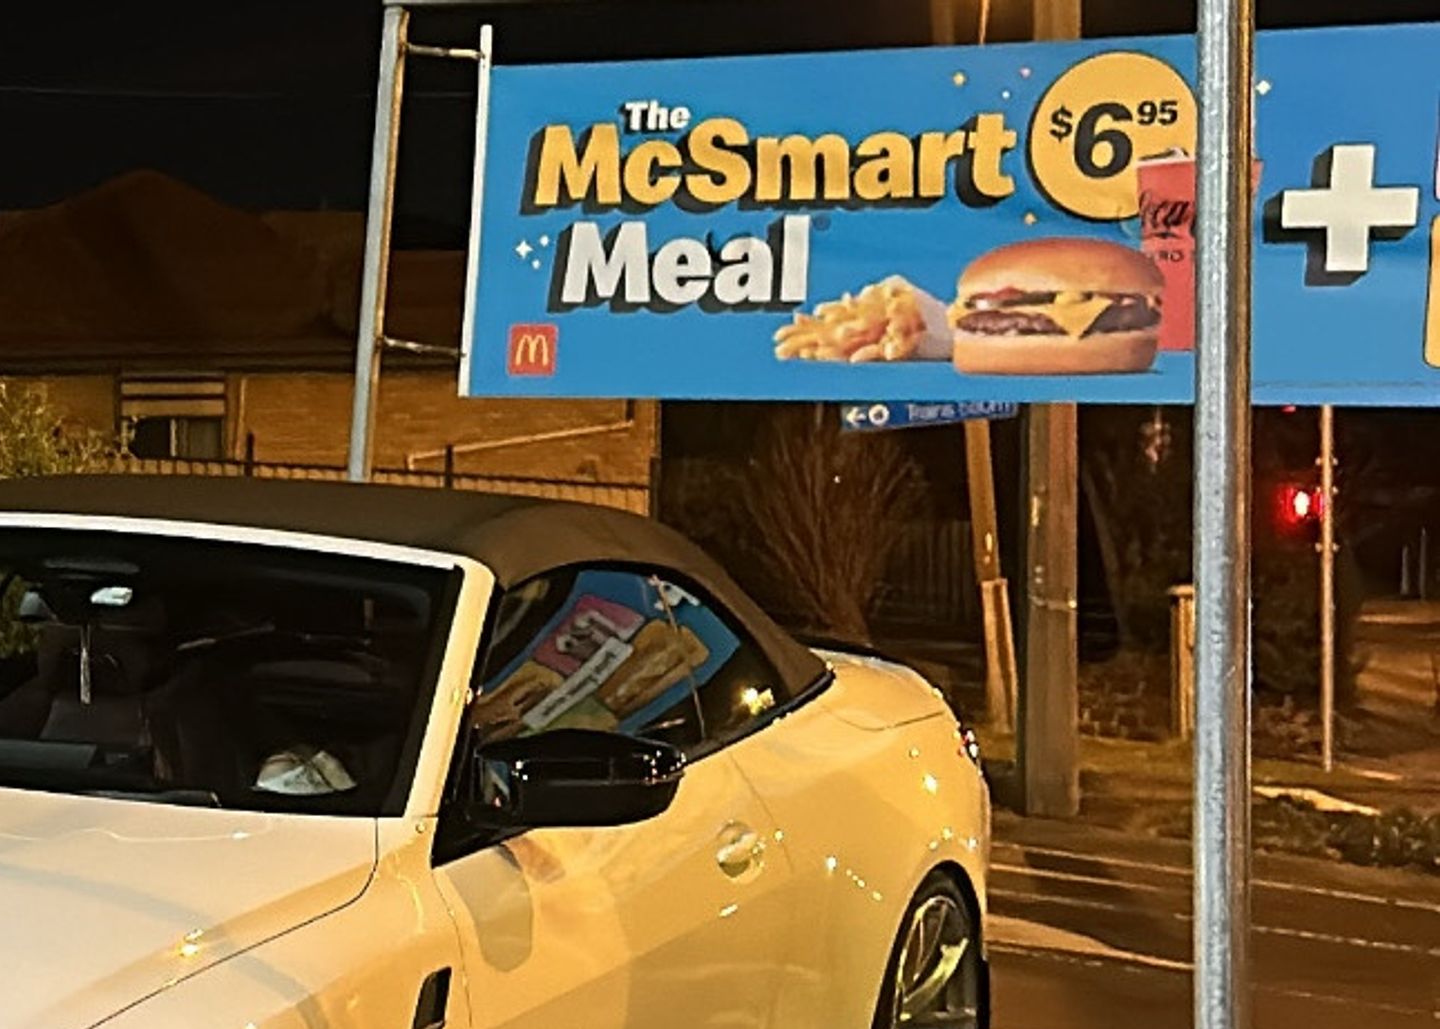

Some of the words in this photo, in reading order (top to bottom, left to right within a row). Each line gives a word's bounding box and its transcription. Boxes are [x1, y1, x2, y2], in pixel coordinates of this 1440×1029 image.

[534, 113, 1017, 205] McSmart
[625, 101, 690, 131] The
[562, 214, 811, 305] Meal
